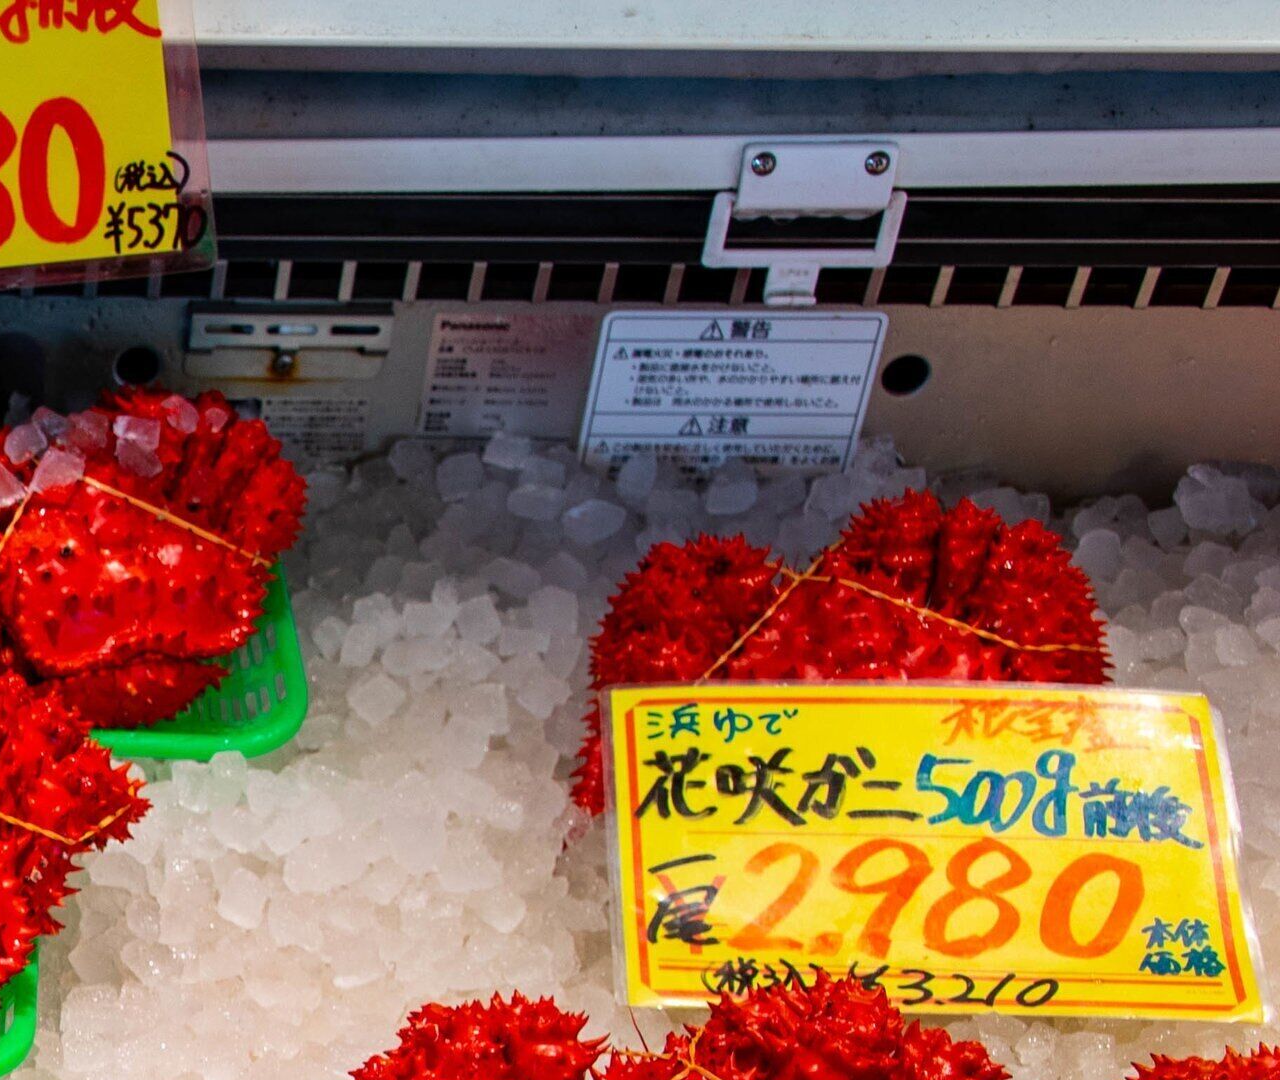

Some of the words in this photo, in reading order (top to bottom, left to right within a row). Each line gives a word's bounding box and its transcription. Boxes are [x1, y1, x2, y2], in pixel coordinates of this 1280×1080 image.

[114, 150, 191, 196] (税込)
[730, 320, 773, 340] 警告
[647, 702, 798, 743] 浜ゆで
[634, 747, 924, 827] 花咲ガニ
[1141, 917, 1210, 949] 本体
[1139, 945, 1226, 978] 価格
